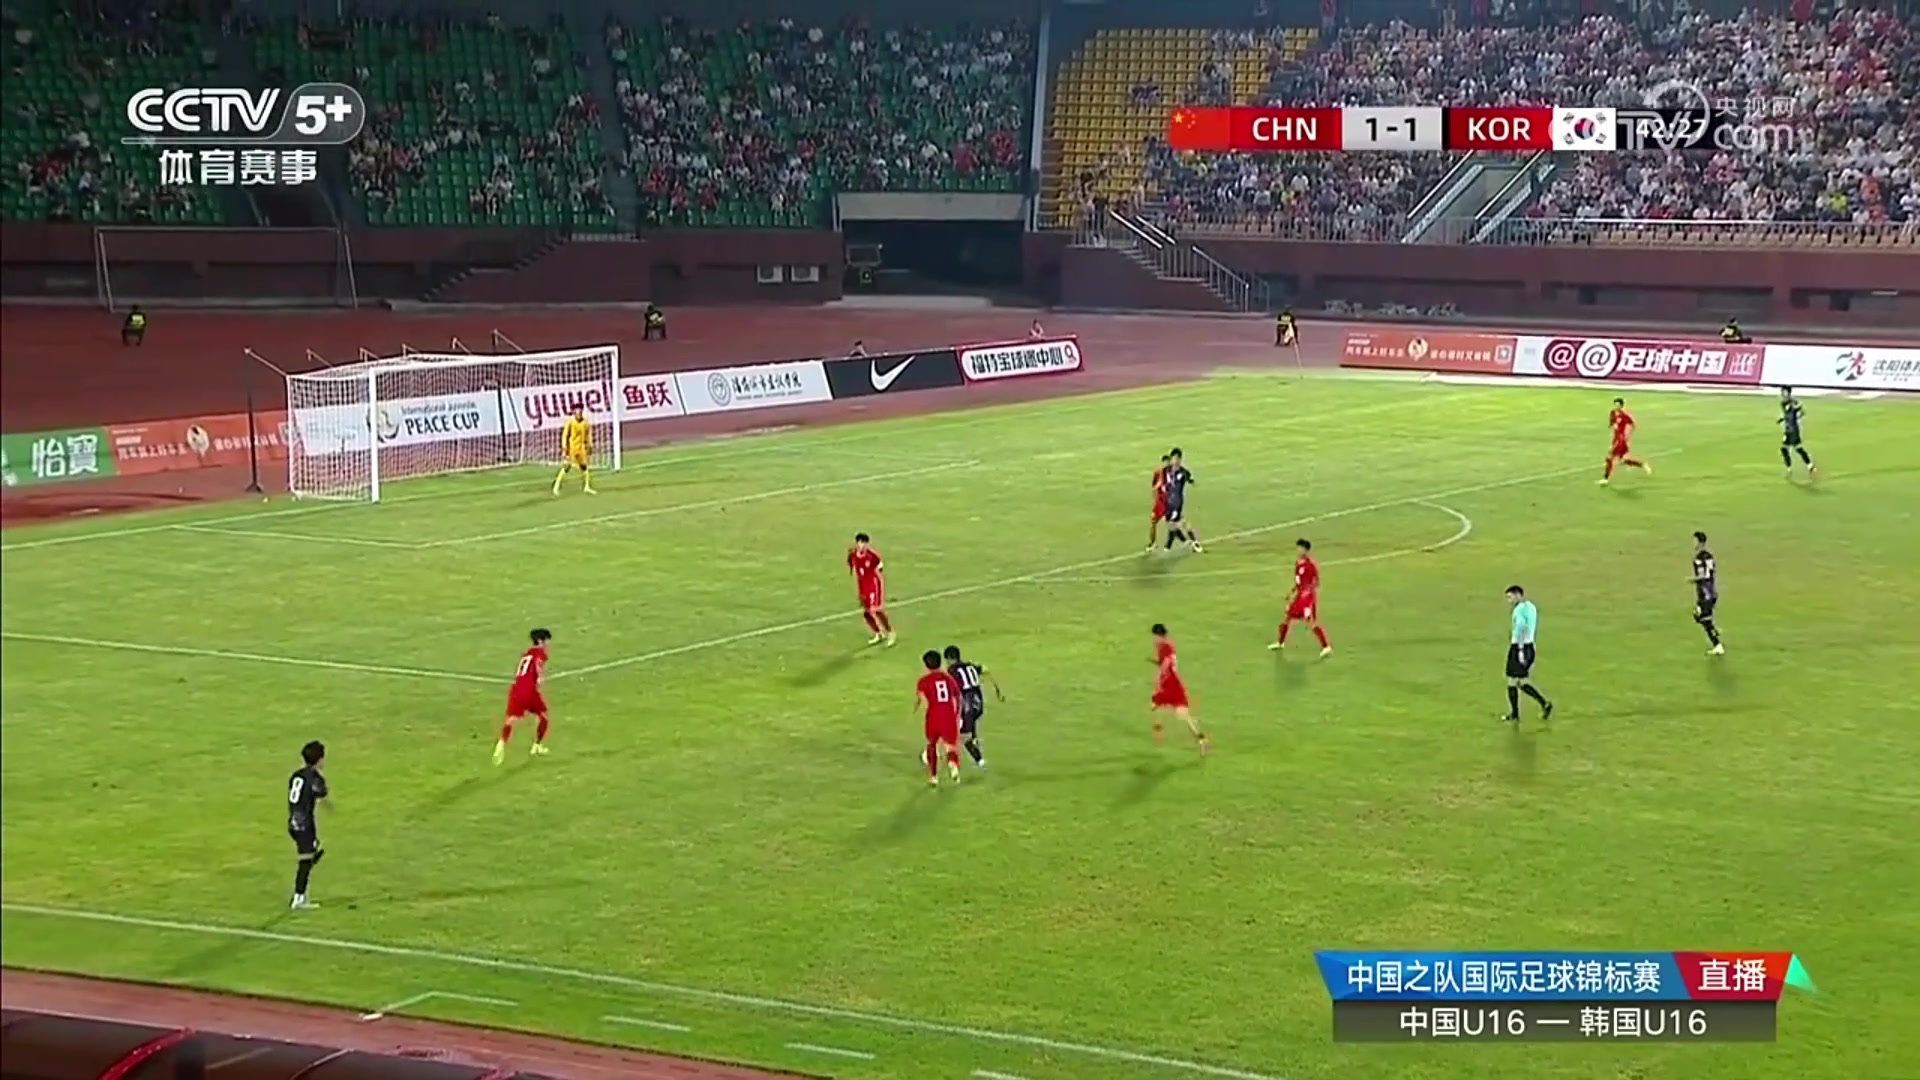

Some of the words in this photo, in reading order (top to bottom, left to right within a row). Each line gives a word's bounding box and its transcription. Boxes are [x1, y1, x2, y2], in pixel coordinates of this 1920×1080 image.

[1617, 348, 1728, 375] 足球中国
[623, 381, 673, 410] 鱼跃
[404, 414, 451, 436] PEACE
[452, 411, 480, 431] CUP
[32, 434, 98, 478] 怡寶
[935, 681, 949, 703] 8
[957, 665, 979, 690] 10
[289, 777, 304, 804] 8
